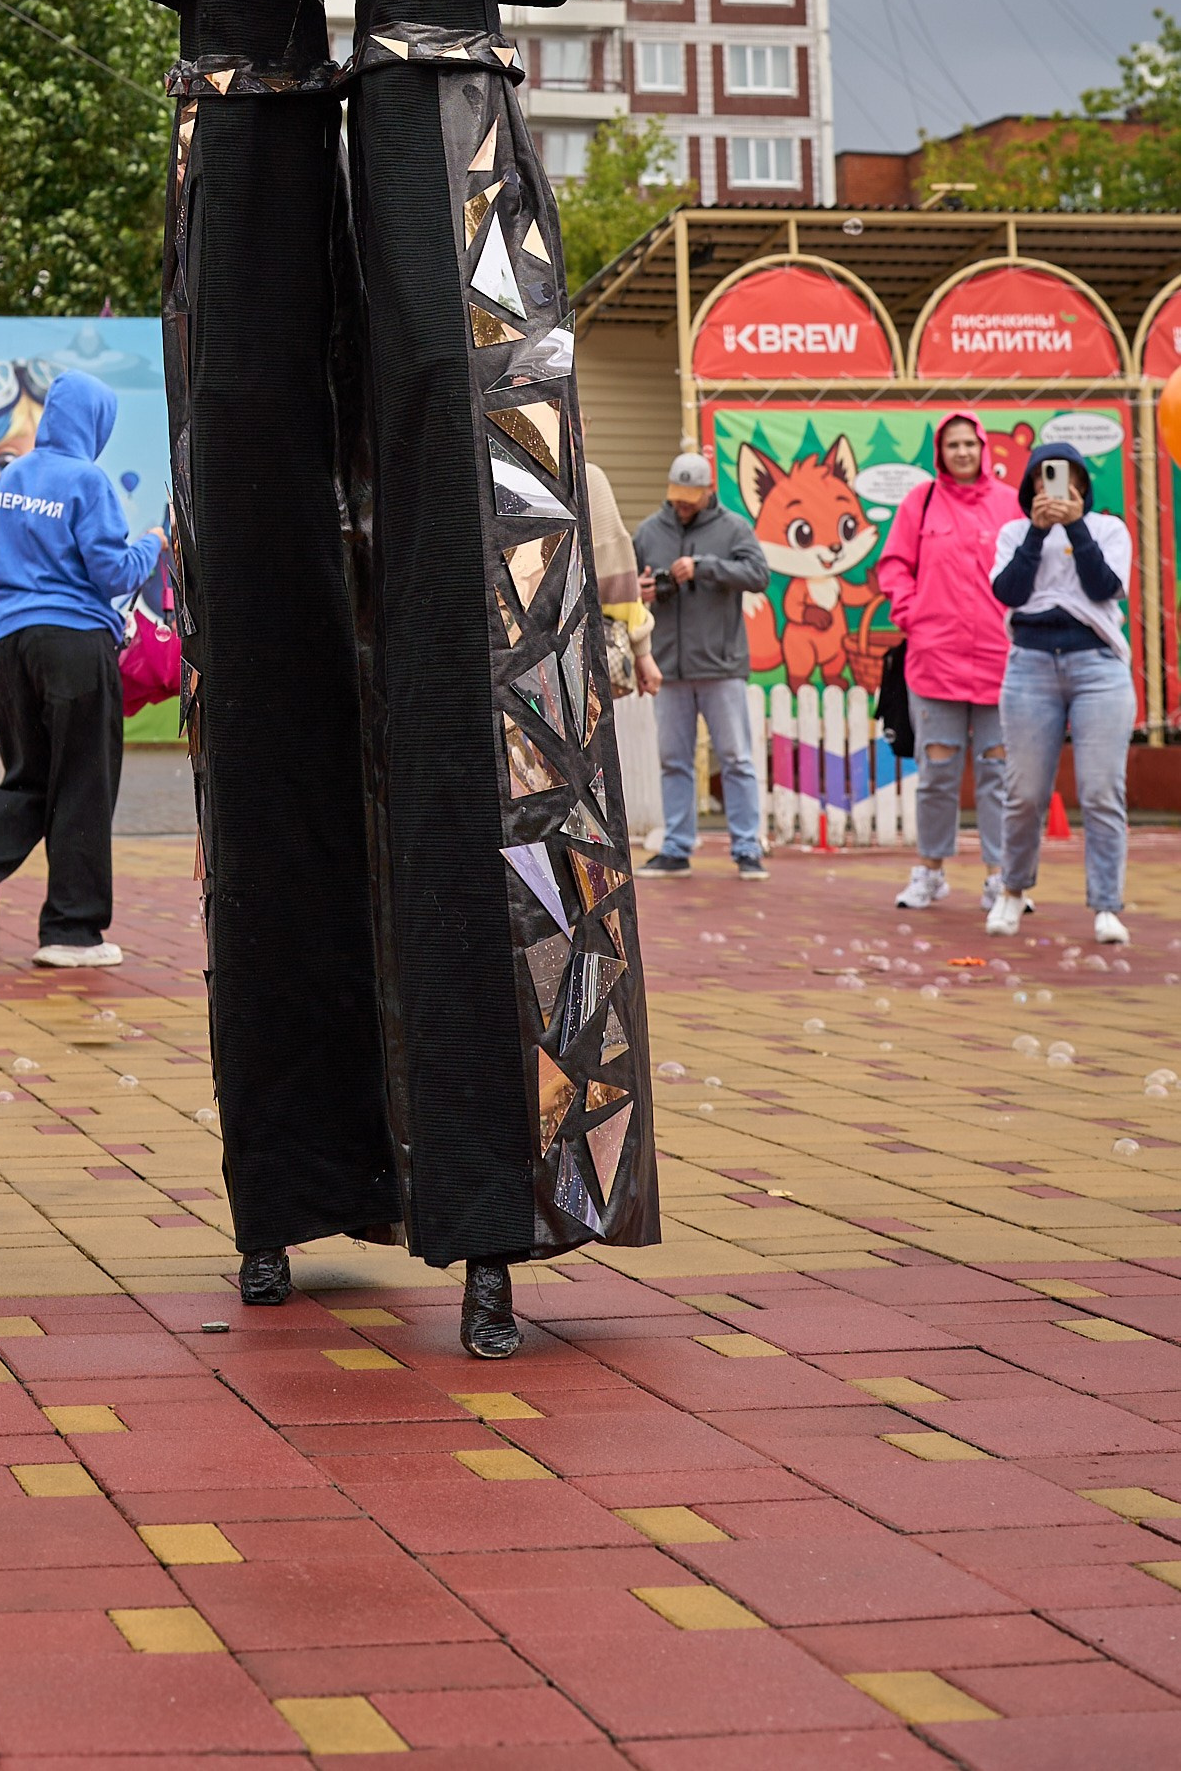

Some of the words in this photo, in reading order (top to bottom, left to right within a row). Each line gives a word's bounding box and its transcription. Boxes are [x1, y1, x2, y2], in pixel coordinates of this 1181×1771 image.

[951, 313, 1055, 329] ЛИСИЧКИНЫ
[723, 323, 858, 353] KBREW
[951, 330, 1073, 353] НАПИТКИ
